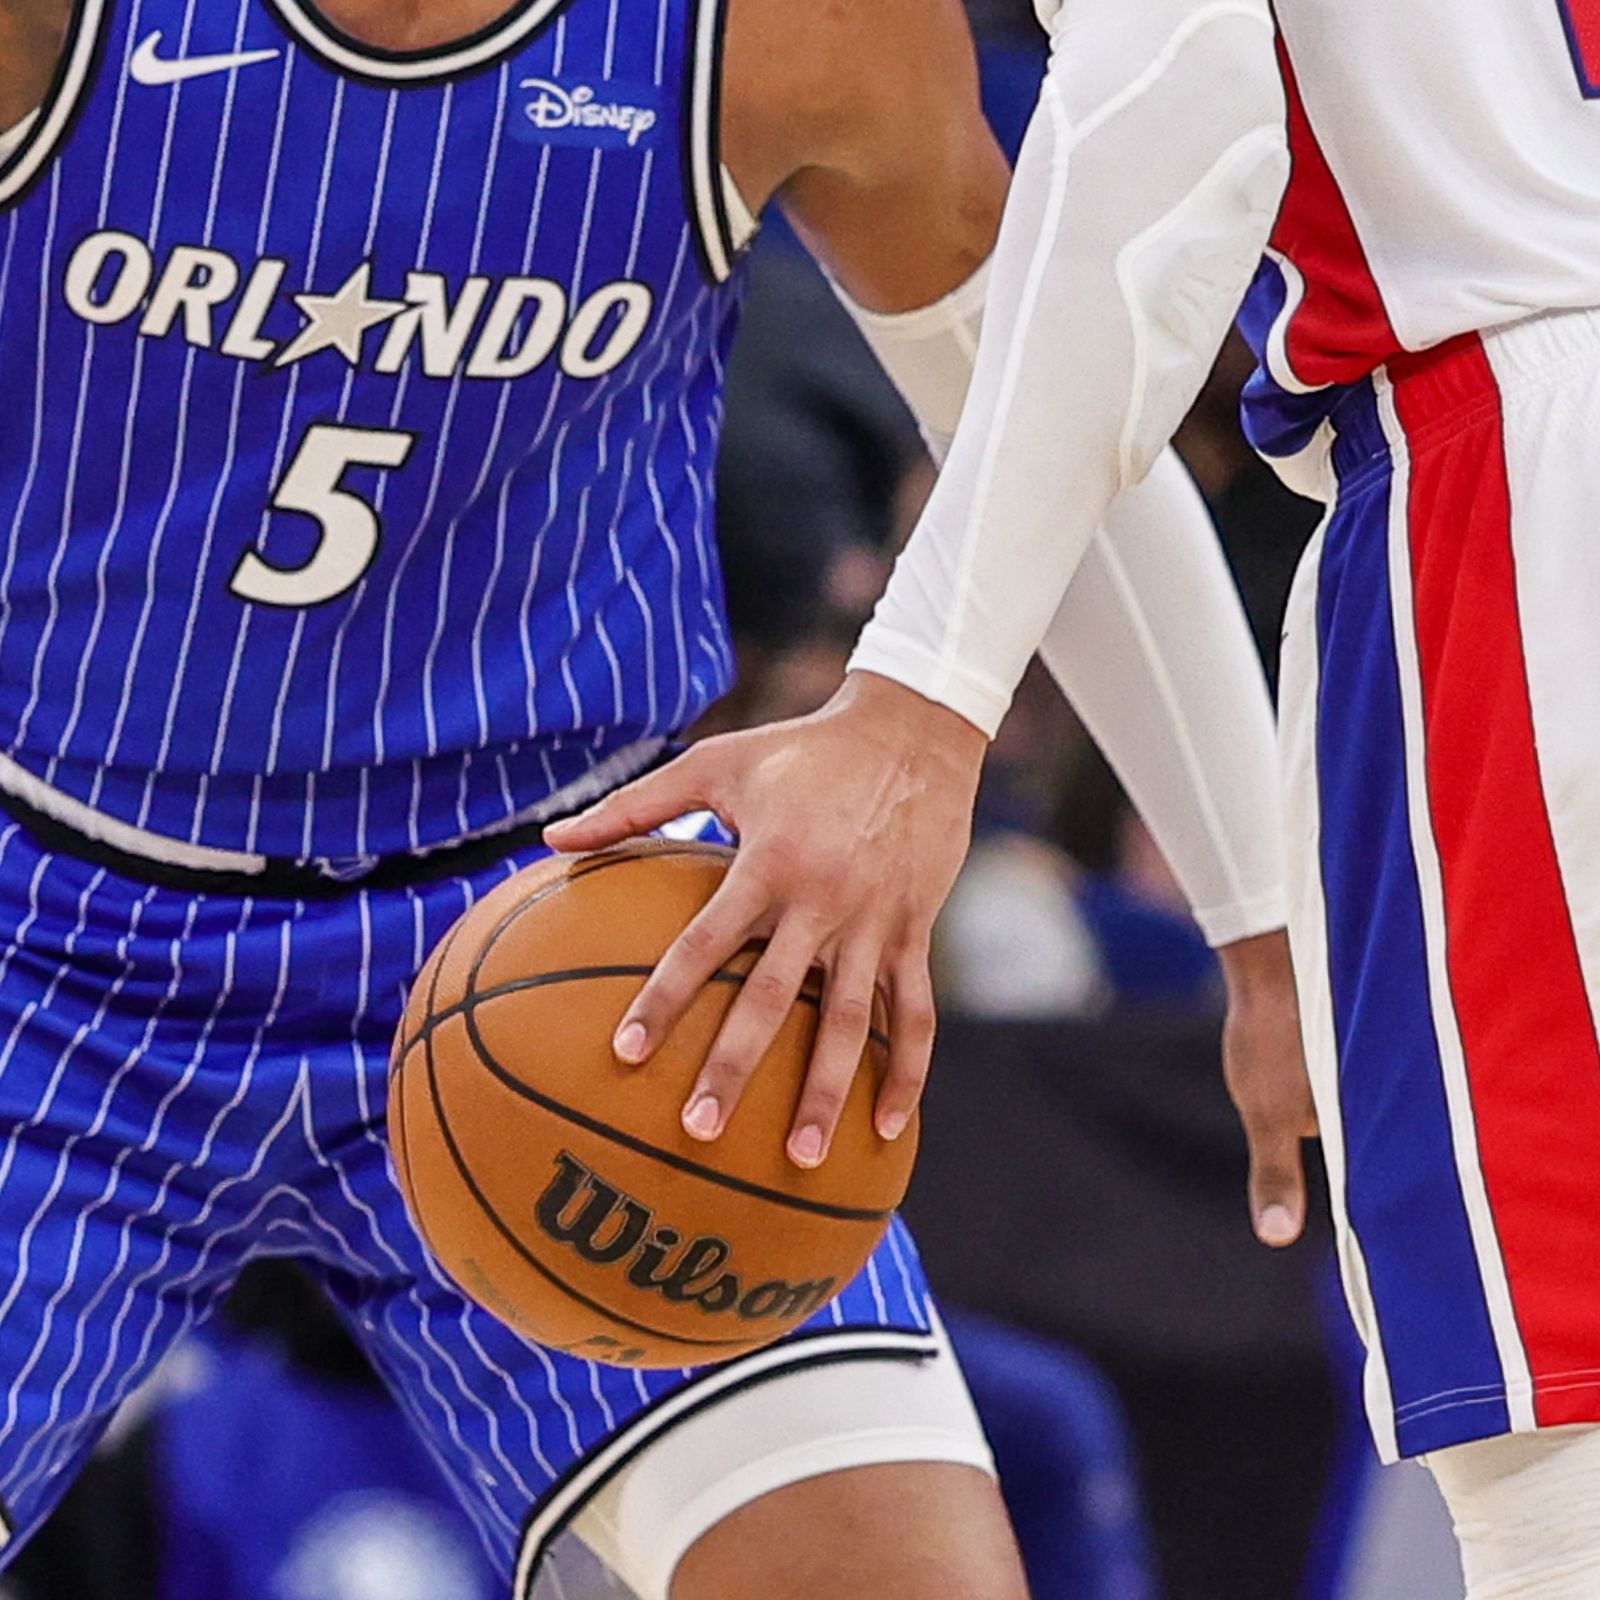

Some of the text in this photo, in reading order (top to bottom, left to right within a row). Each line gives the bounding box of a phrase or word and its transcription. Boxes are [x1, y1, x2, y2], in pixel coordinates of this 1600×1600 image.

[519, 78, 657, 146] Disney
[228, 422, 416, 610] 5
[534, 1150, 837, 1318] Wilson
